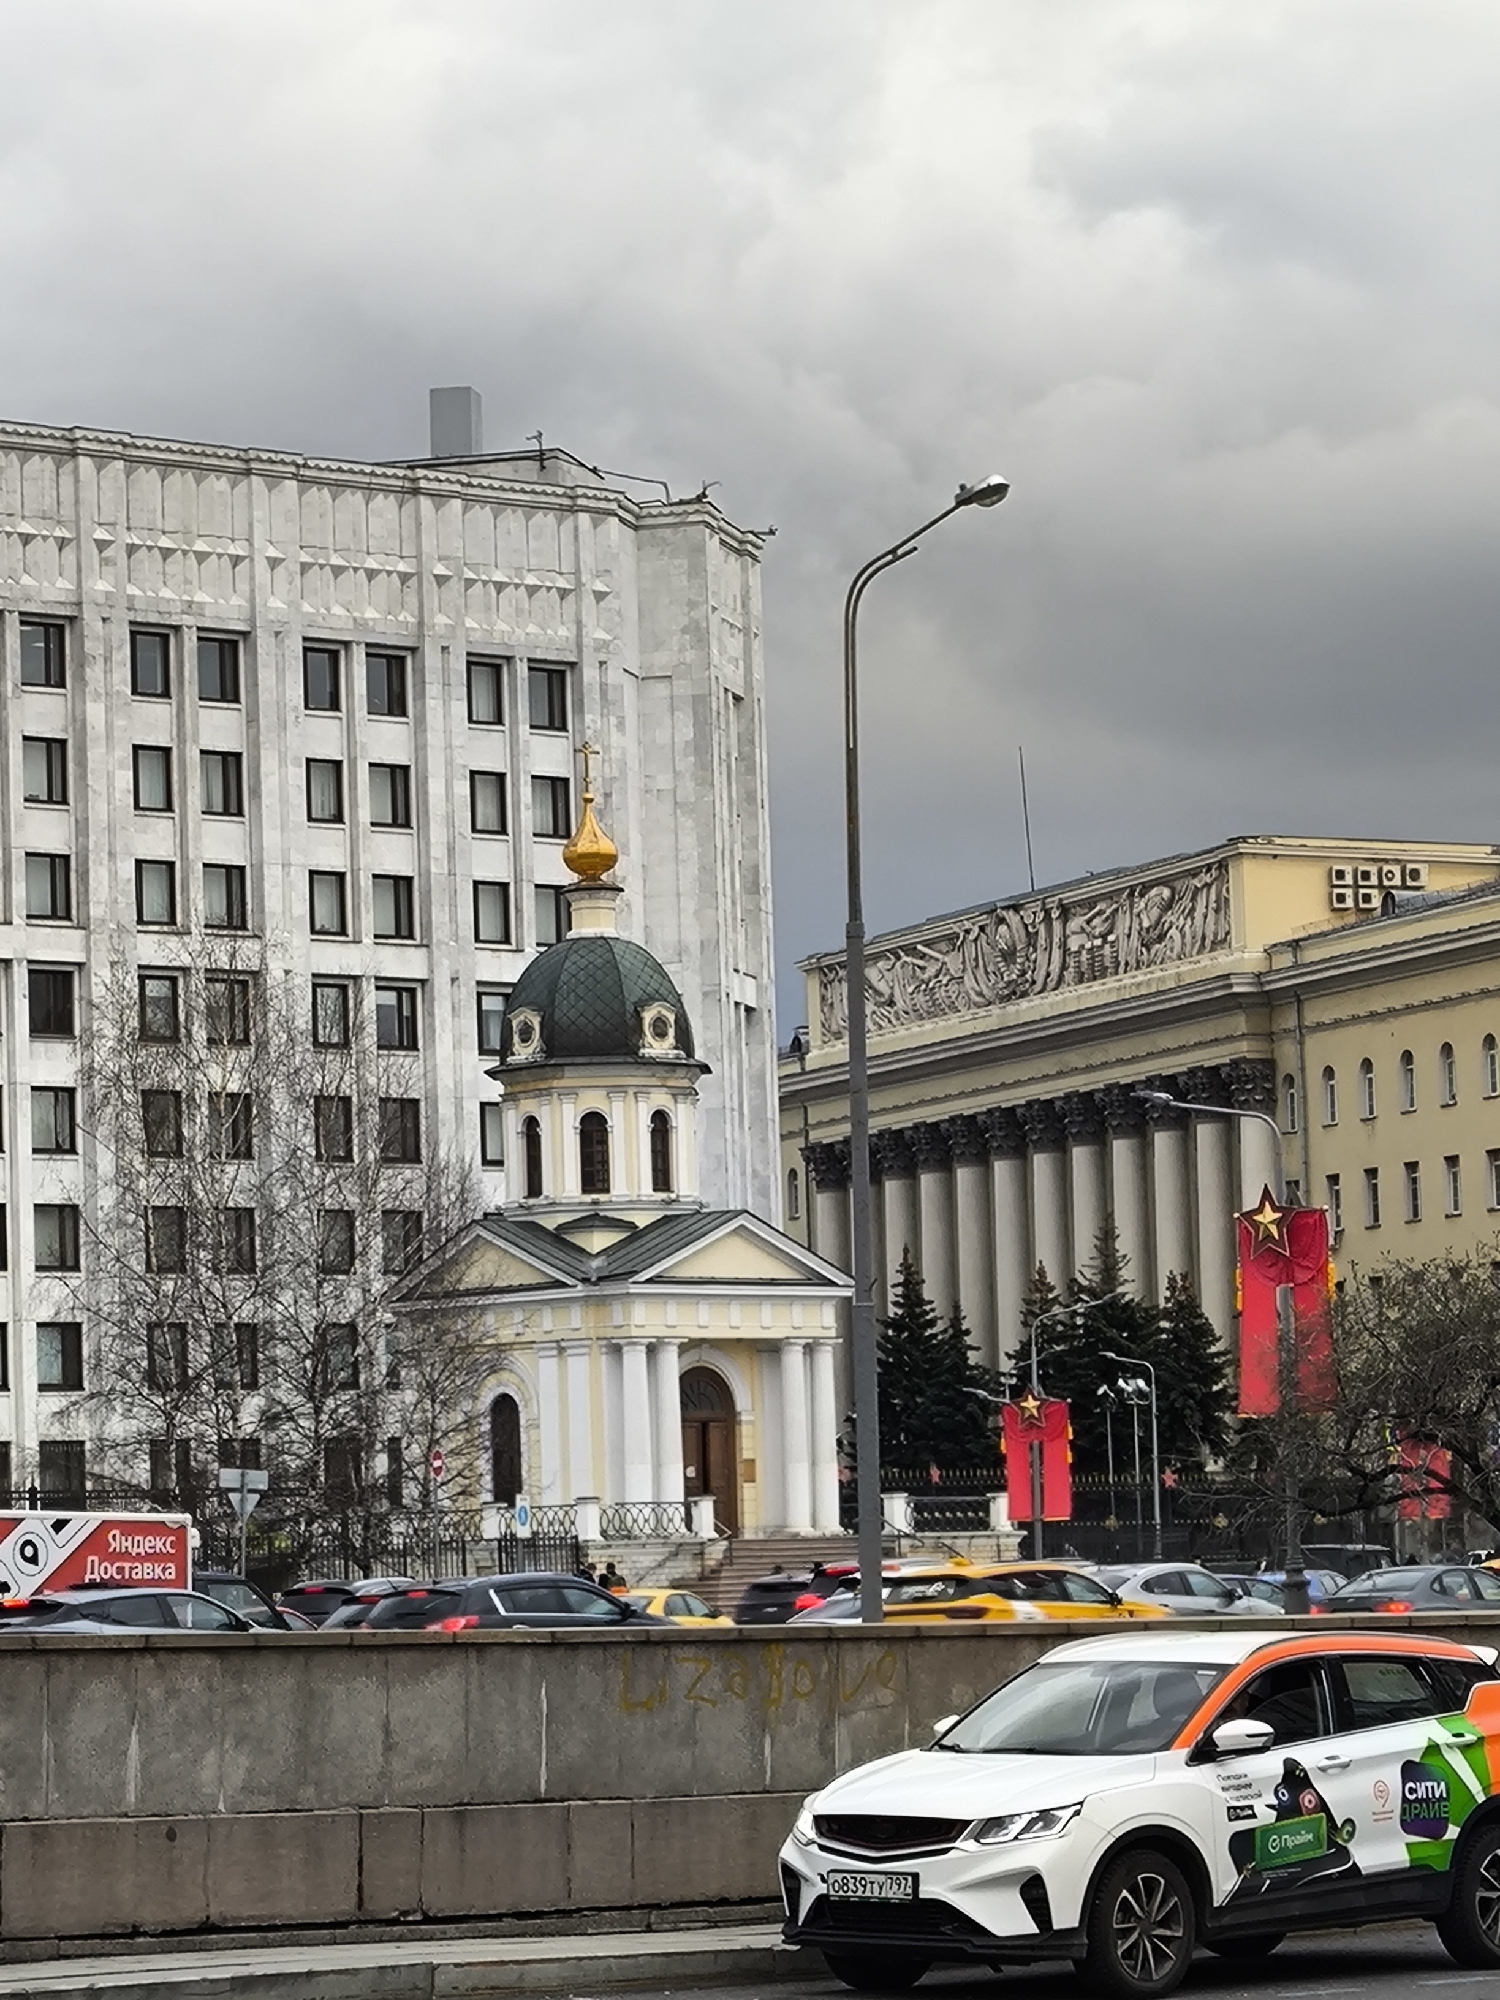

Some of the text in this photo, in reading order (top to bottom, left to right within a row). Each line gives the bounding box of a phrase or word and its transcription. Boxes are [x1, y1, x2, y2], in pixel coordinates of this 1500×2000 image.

[108, 1529, 176, 1556] Яндекс
[85, 1556, 176, 1583] Доставка
[1405, 1781, 1447, 1800] СИТИ
[1281, 1830, 1314, 1849] Прайм
